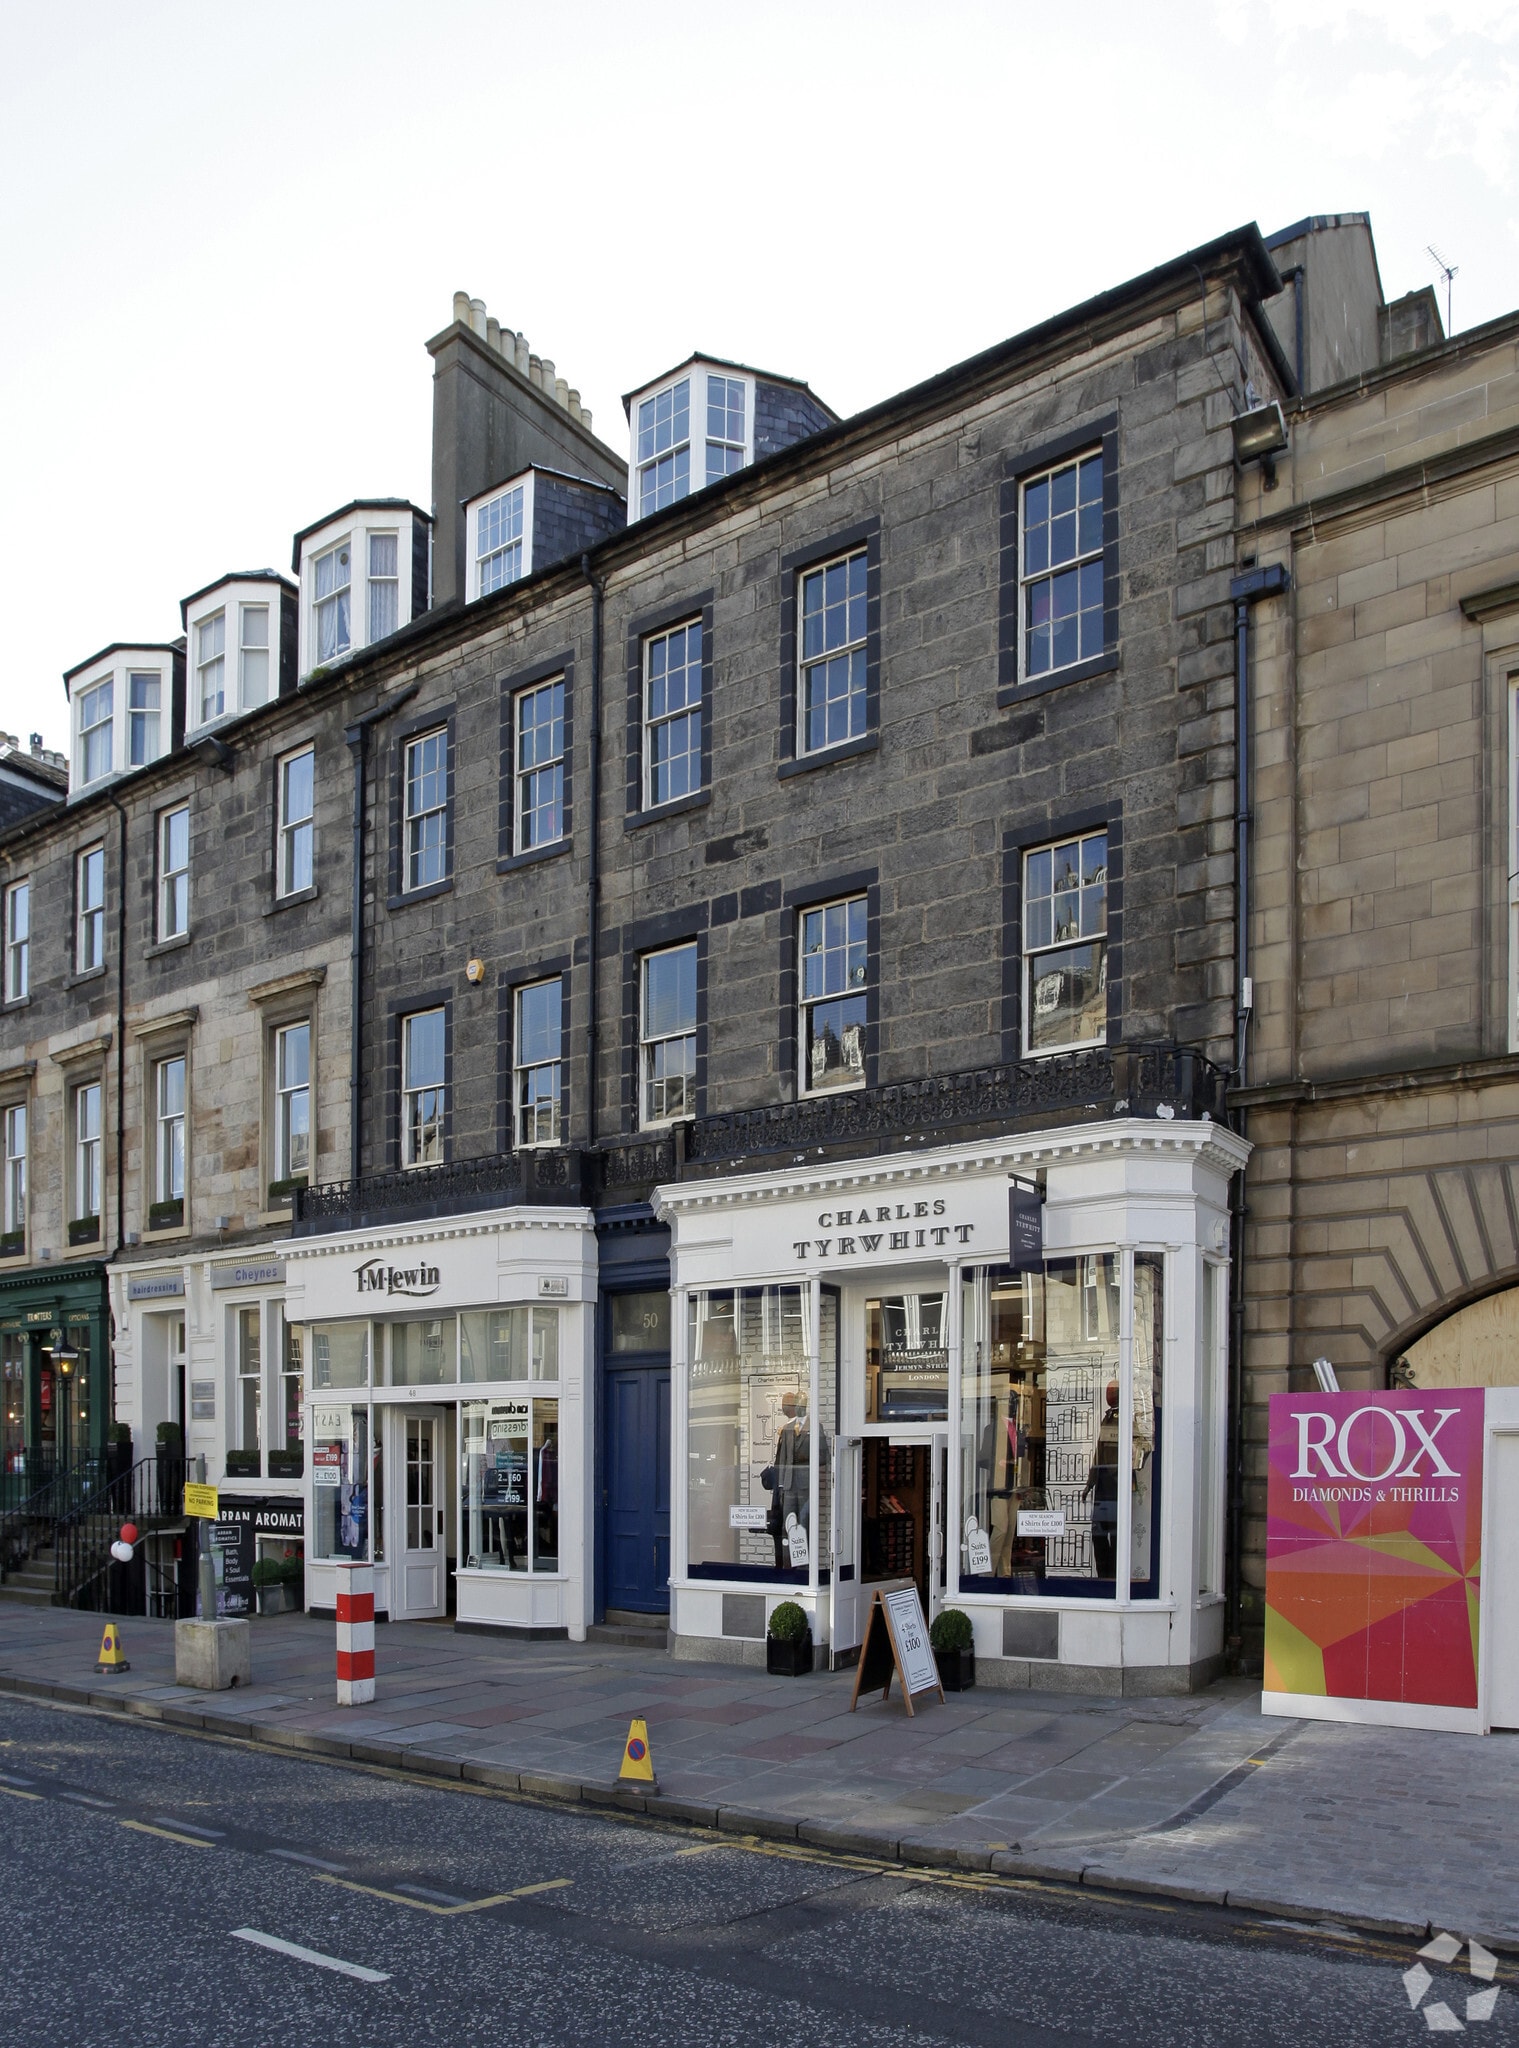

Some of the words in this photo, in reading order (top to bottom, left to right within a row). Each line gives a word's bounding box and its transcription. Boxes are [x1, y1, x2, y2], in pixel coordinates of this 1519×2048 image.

[818, 1199, 945, 1228] CHARLES
[793, 1223, 974, 1259] TYRWHITT
[235, 1266, 277, 1282] Cheynes
[132, 1282, 177, 1295] hairdressing
[27, 1311, 52, 1322] TROTTERS
[643, 1312, 658, 1328] 50
[1289, 1406, 1462, 1482] ROX
[1293, 1487, 1372, 1502] DIAMONDS
[1375, 1489, 1386, 1502] &
[1390, 1487, 1459, 1502] THRILLS
[1025, 1519, 1041, 1527] Shirts
[1041, 1519, 1050, 1527] for
[791, 1537, 805, 1545] Suits
[971, 1541, 987, 1550] Suits
[792, 1549, 807, 1559] £199
[225, 1557, 239, 1566] Body
[972, 1555, 989, 1566] £199
[225, 1575, 250, 1583] Essentials
[905, 1636, 921, 1652] £100
